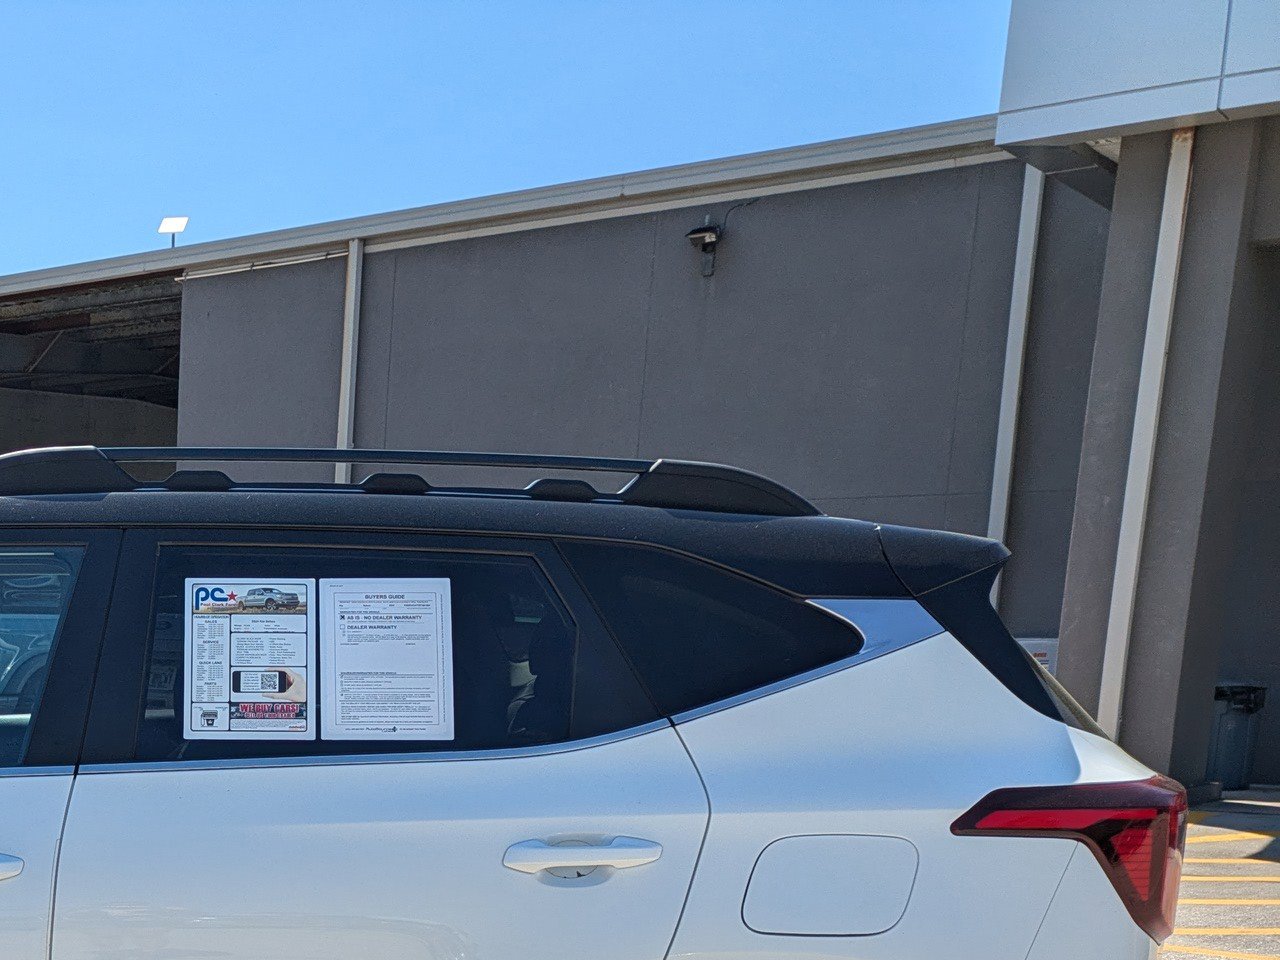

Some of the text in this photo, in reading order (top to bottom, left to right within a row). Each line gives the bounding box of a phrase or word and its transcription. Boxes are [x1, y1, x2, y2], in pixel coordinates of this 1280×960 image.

[240, 703, 299, 713] WE BUY CARS!
